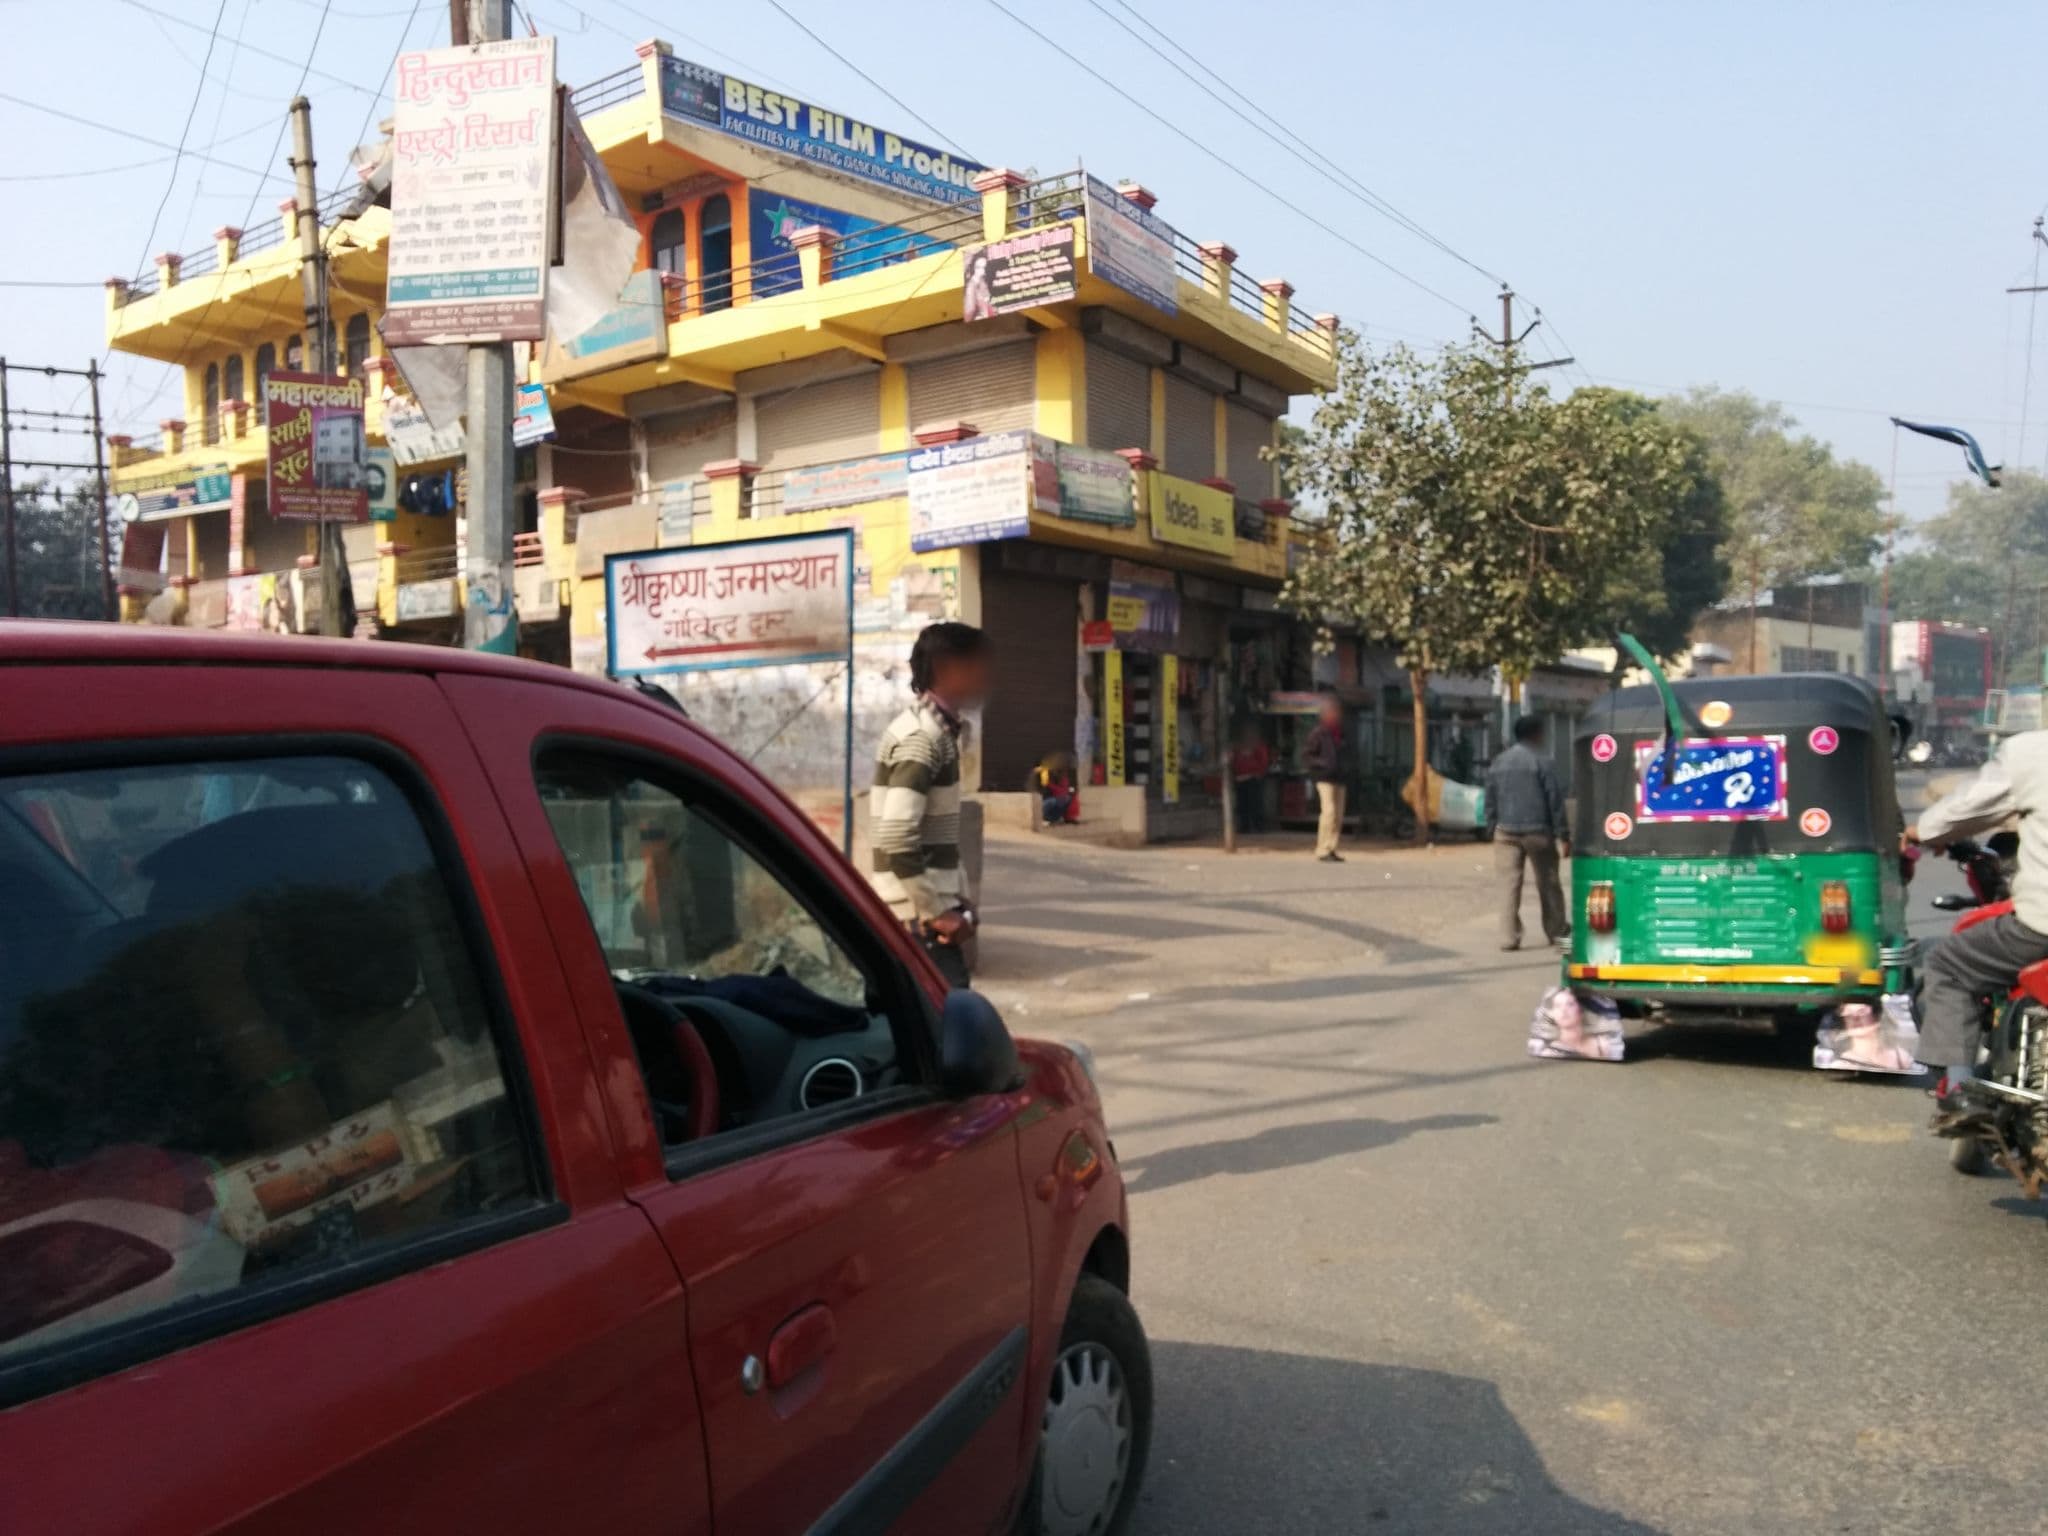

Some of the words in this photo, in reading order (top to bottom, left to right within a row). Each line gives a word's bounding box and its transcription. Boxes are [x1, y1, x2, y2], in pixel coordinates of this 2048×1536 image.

[396, 54, 547, 108] हिन्दुस्तान
[396, 117, 458, 163] एस्ट्रो
[464, 107, 541, 150] रिसर्च
[724, 76, 800, 131] BEST
[808, 106, 876, 158] FILM
[725, 115, 785, 147] FACILITIES
[267, 378, 363, 408] महालक्ष्मी
[713, 554, 839, 599] जन्मस्थान
